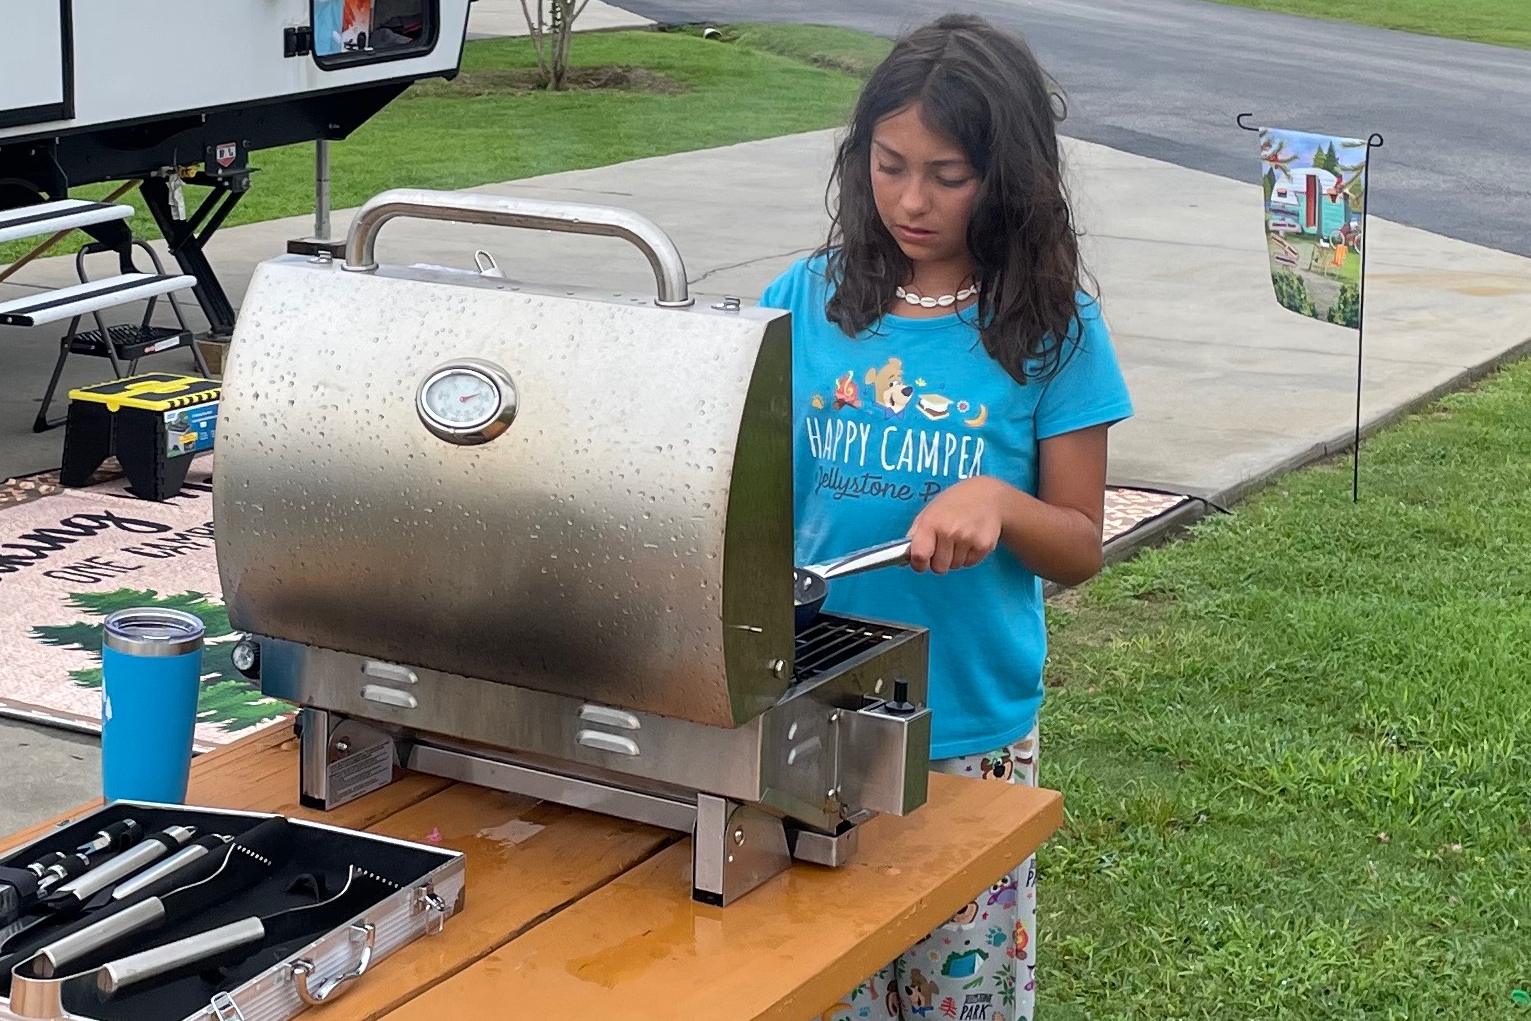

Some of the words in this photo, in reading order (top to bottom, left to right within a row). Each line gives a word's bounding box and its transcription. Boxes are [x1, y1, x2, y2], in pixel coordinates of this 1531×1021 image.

[806, 417, 871, 467] HAPPY
[880, 425, 986, 480] CAMPER
[814, 465, 915, 501] Jellystone
[42, 555, 144, 584] ONE
[959, 1003, 994, 1021] PARK
